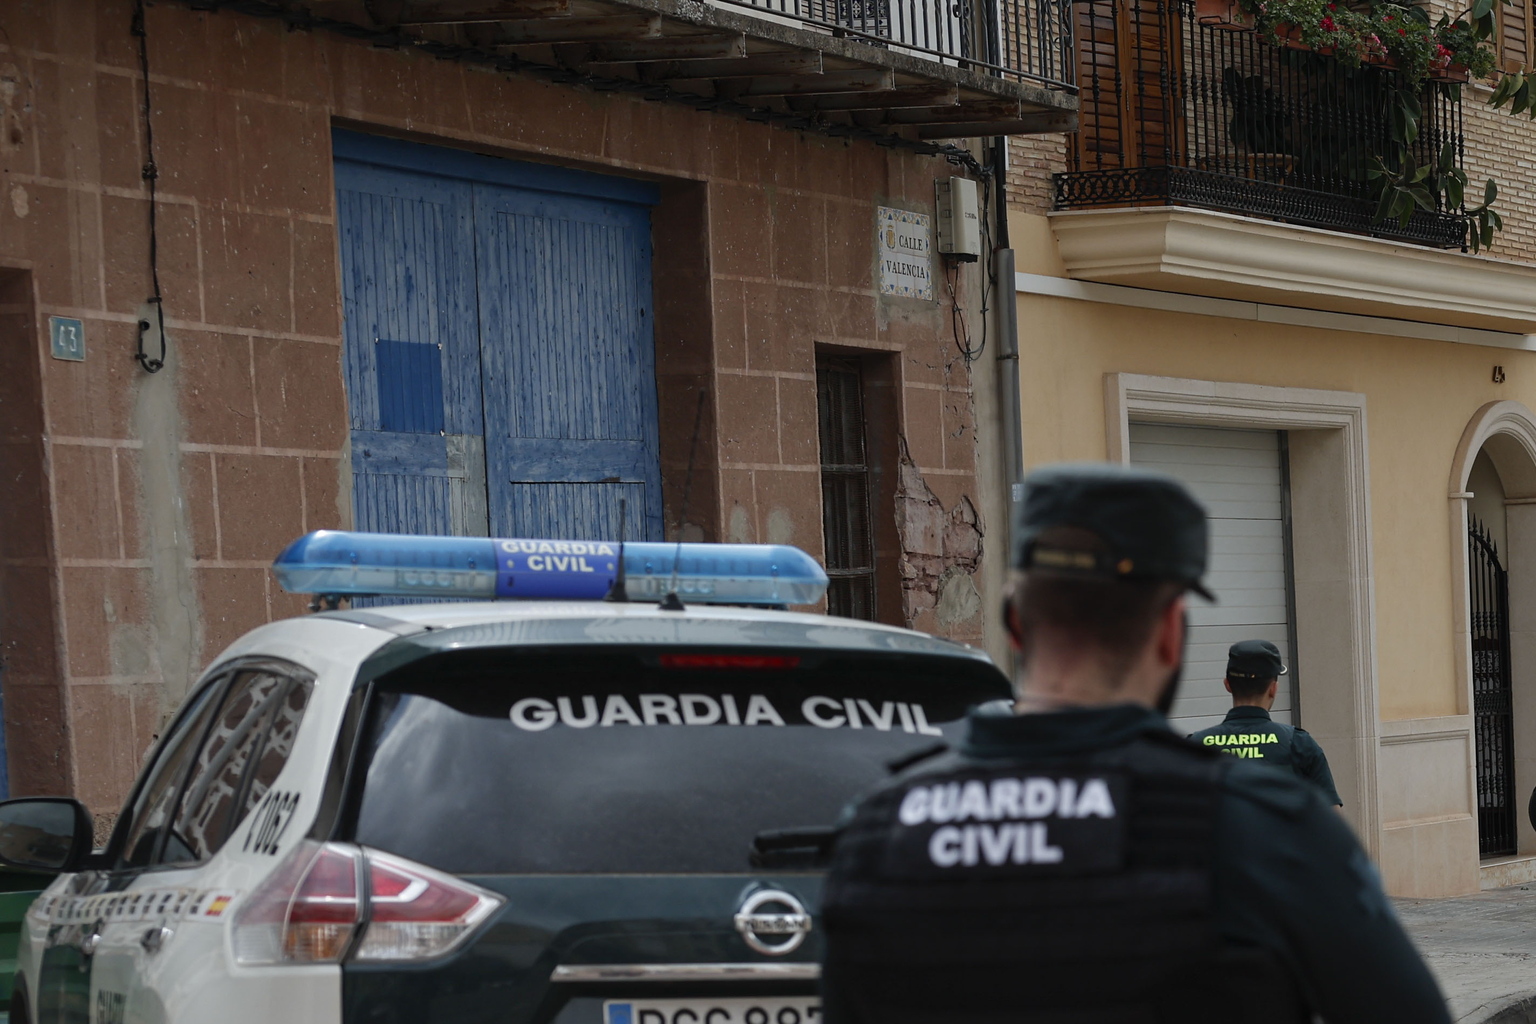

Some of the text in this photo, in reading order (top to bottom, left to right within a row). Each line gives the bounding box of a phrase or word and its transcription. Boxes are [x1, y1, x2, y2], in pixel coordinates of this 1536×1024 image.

[899, 235, 923, 251] CALLE
[886, 260, 925, 279] VALENCIA
[501, 541, 615, 556] GUARDIA
[527, 555, 594, 572] CIVIL
[509, 694, 943, 737] GUARDIA CIVIL
[1203, 733, 1278, 746] GUARDIA
[899, 777, 1115, 825] GUARDIA
[928, 822, 1064, 867] CIVIL
